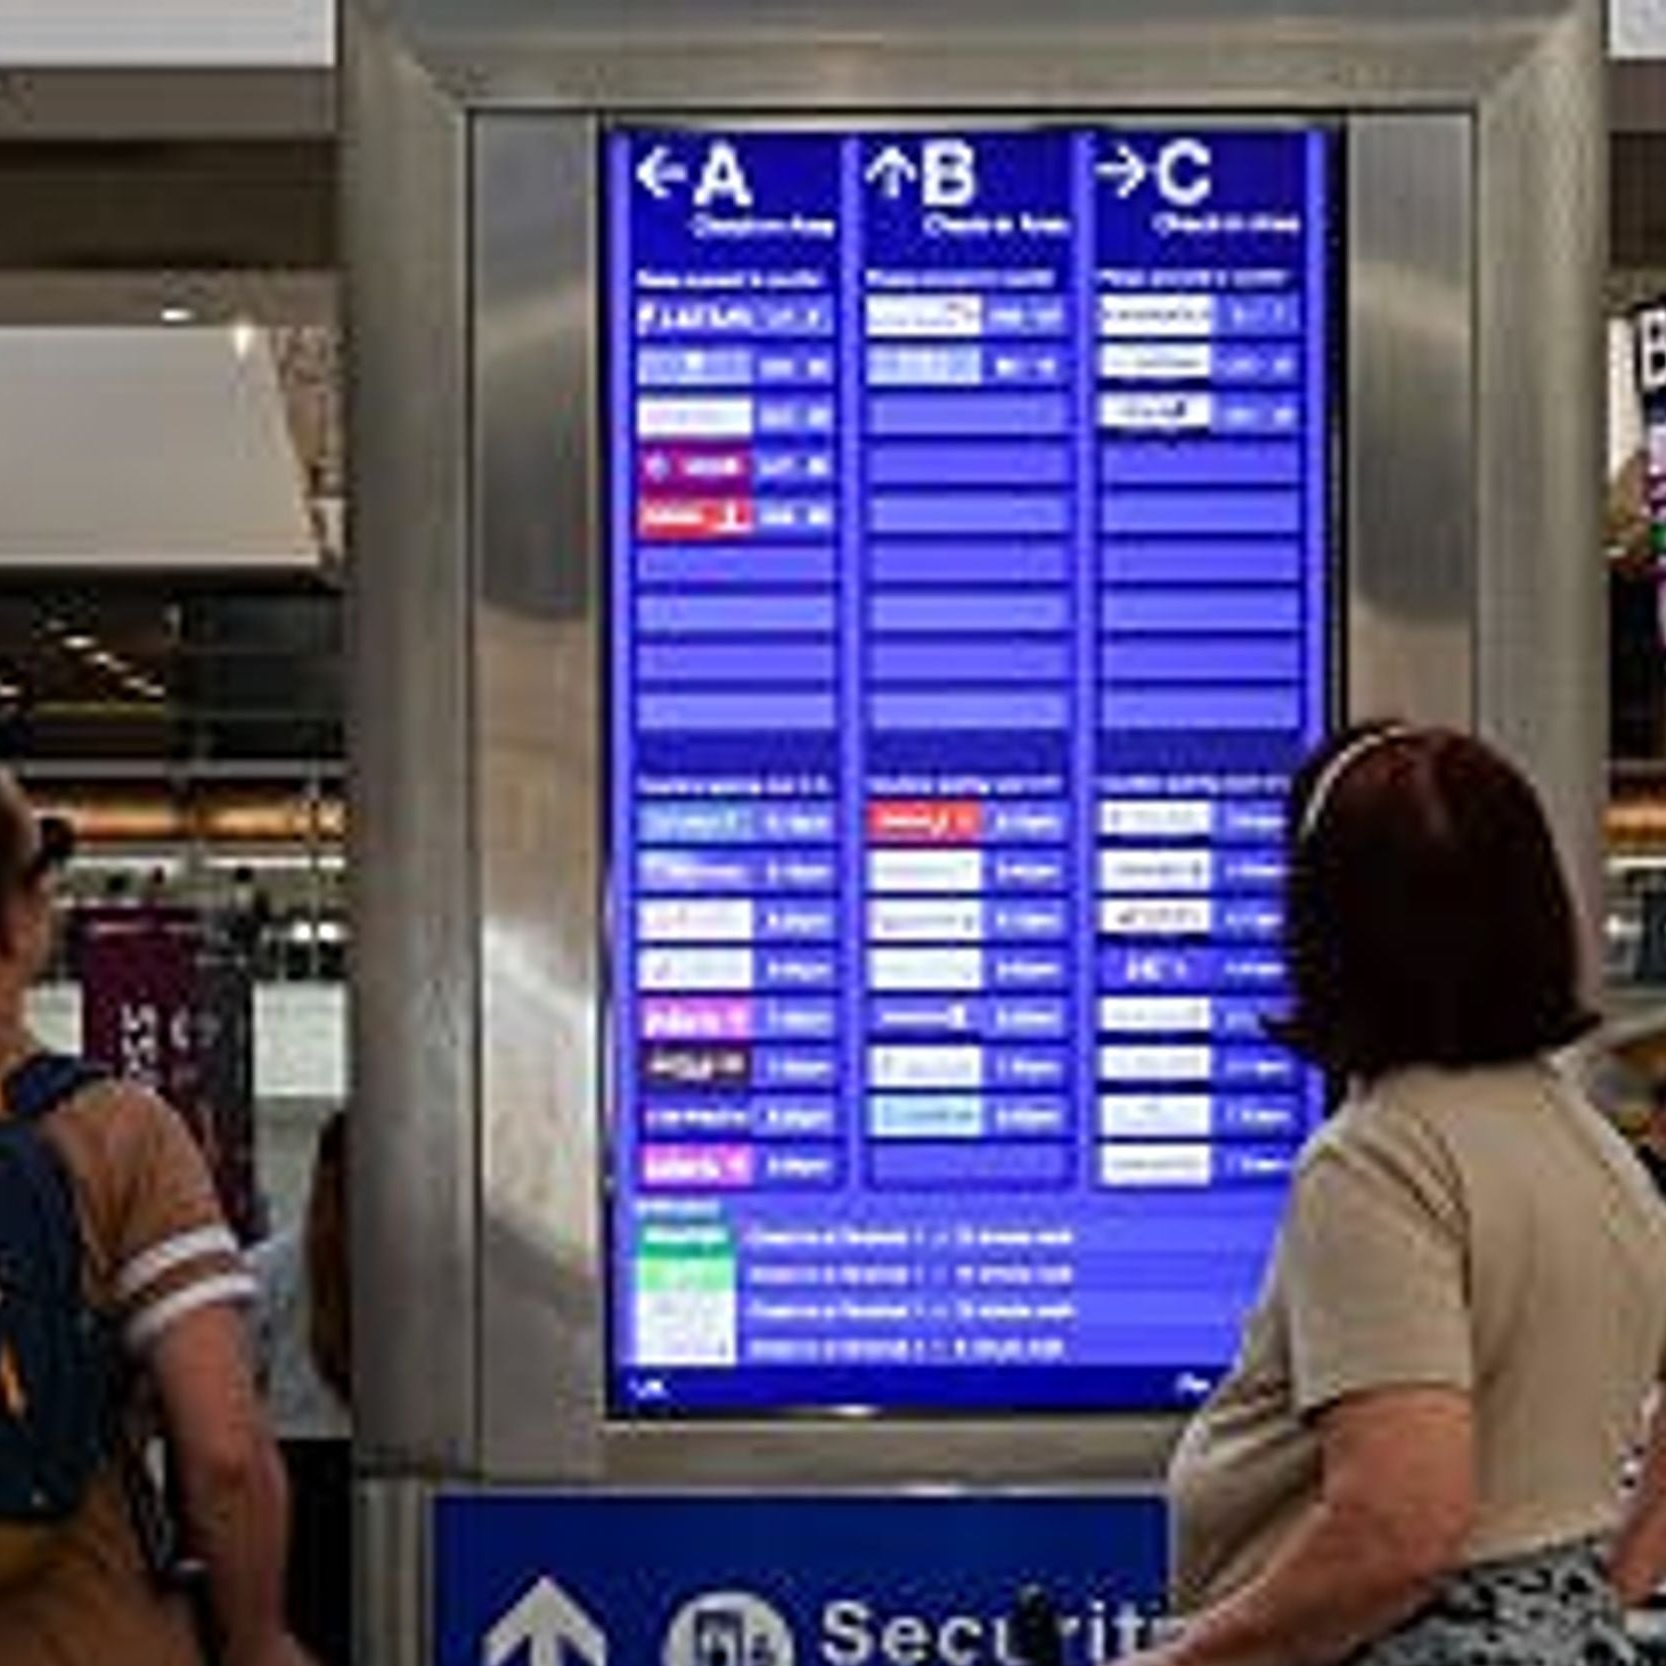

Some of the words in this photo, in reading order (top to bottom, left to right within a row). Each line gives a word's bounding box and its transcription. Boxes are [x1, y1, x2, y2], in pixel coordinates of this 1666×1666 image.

[692, 140, 753, 206] A
[922, 139, 975, 206] B
[1158, 138, 1212, 206] C
